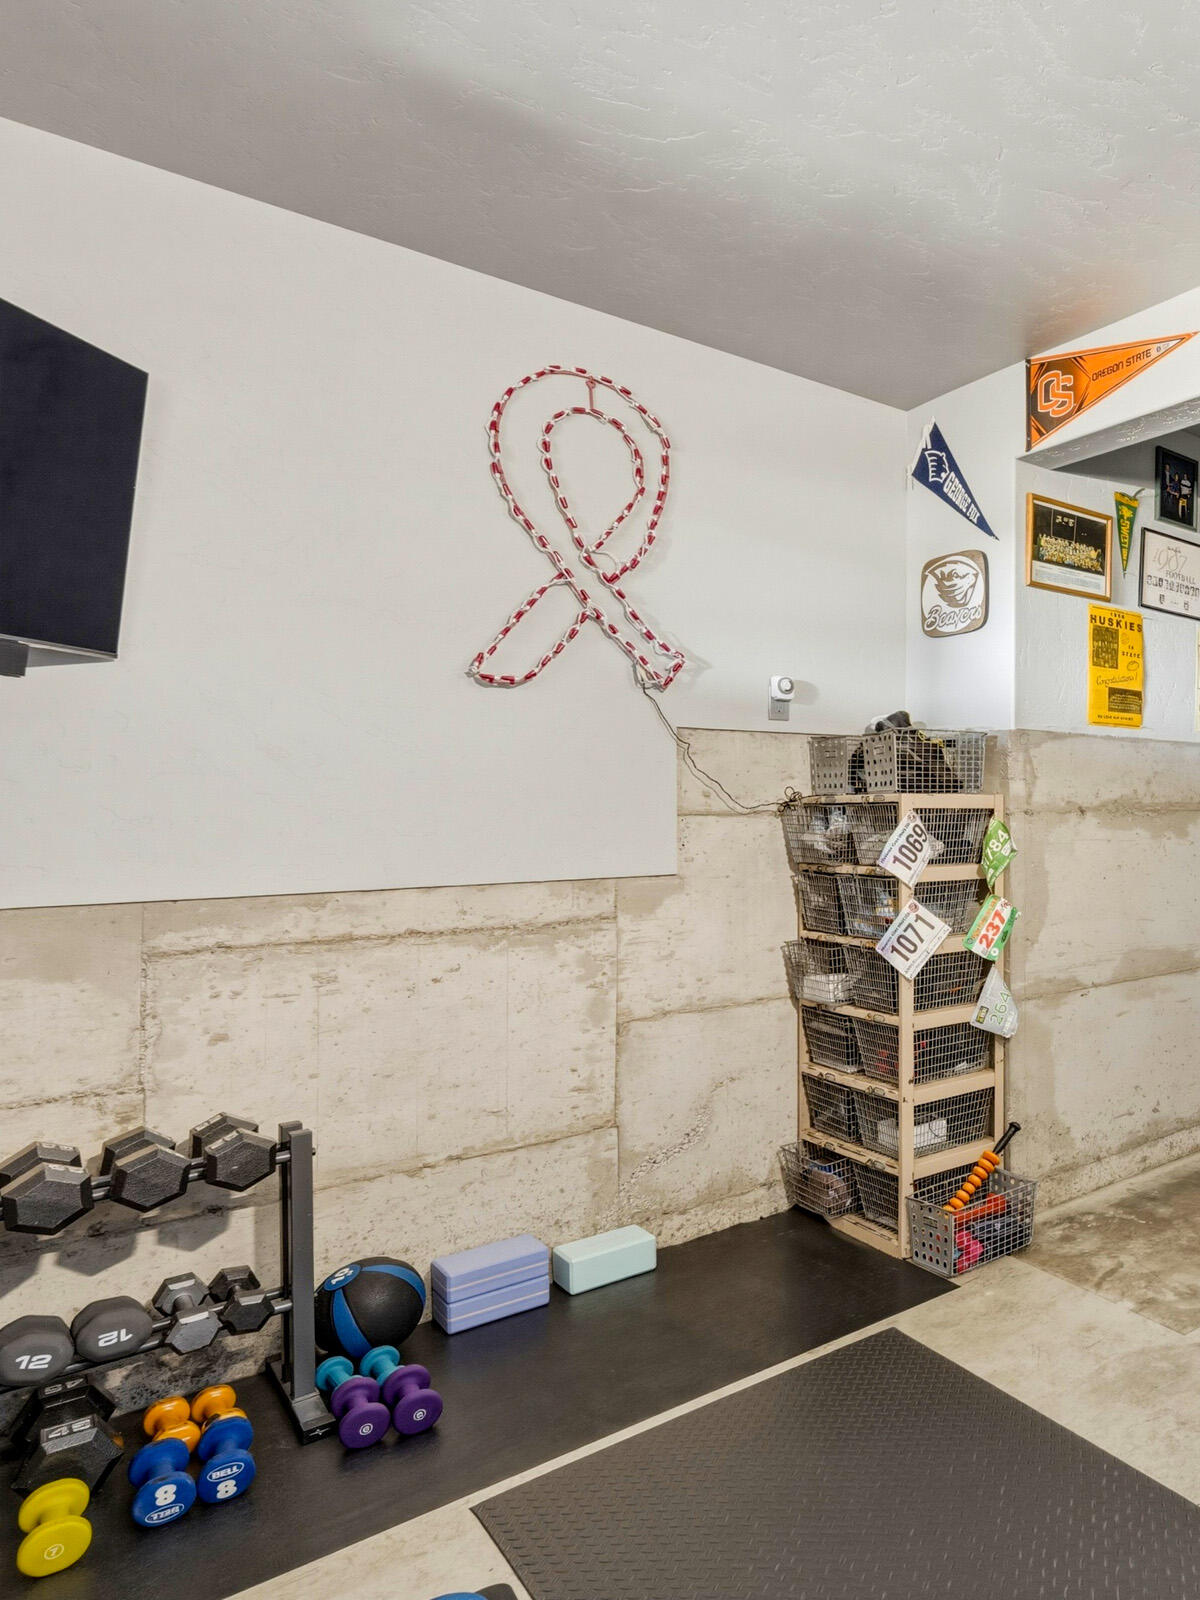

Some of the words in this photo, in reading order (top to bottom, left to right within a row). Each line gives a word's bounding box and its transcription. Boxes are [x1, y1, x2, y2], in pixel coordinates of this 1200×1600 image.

[1091, 362, 1124, 382] OREGON
[1125, 347, 1152, 368] STATE
[943, 472, 972, 512] GEORGE
[966, 506, 981, 524] FOX
[1090, 614, 1143, 632] HUSKIES
[892, 823, 928, 871] 1069
[890, 913, 935, 962] 1071
[978, 911, 1005, 950] 237
[990, 992, 1012, 1025] 264
[97, 1328, 133, 1348] 12
[15, 1354, 52, 1370] 12
[211, 1465, 239, 1480] BELL
[154, 1483, 177, 1506] 8
[216, 1480, 238, 1499] 8
